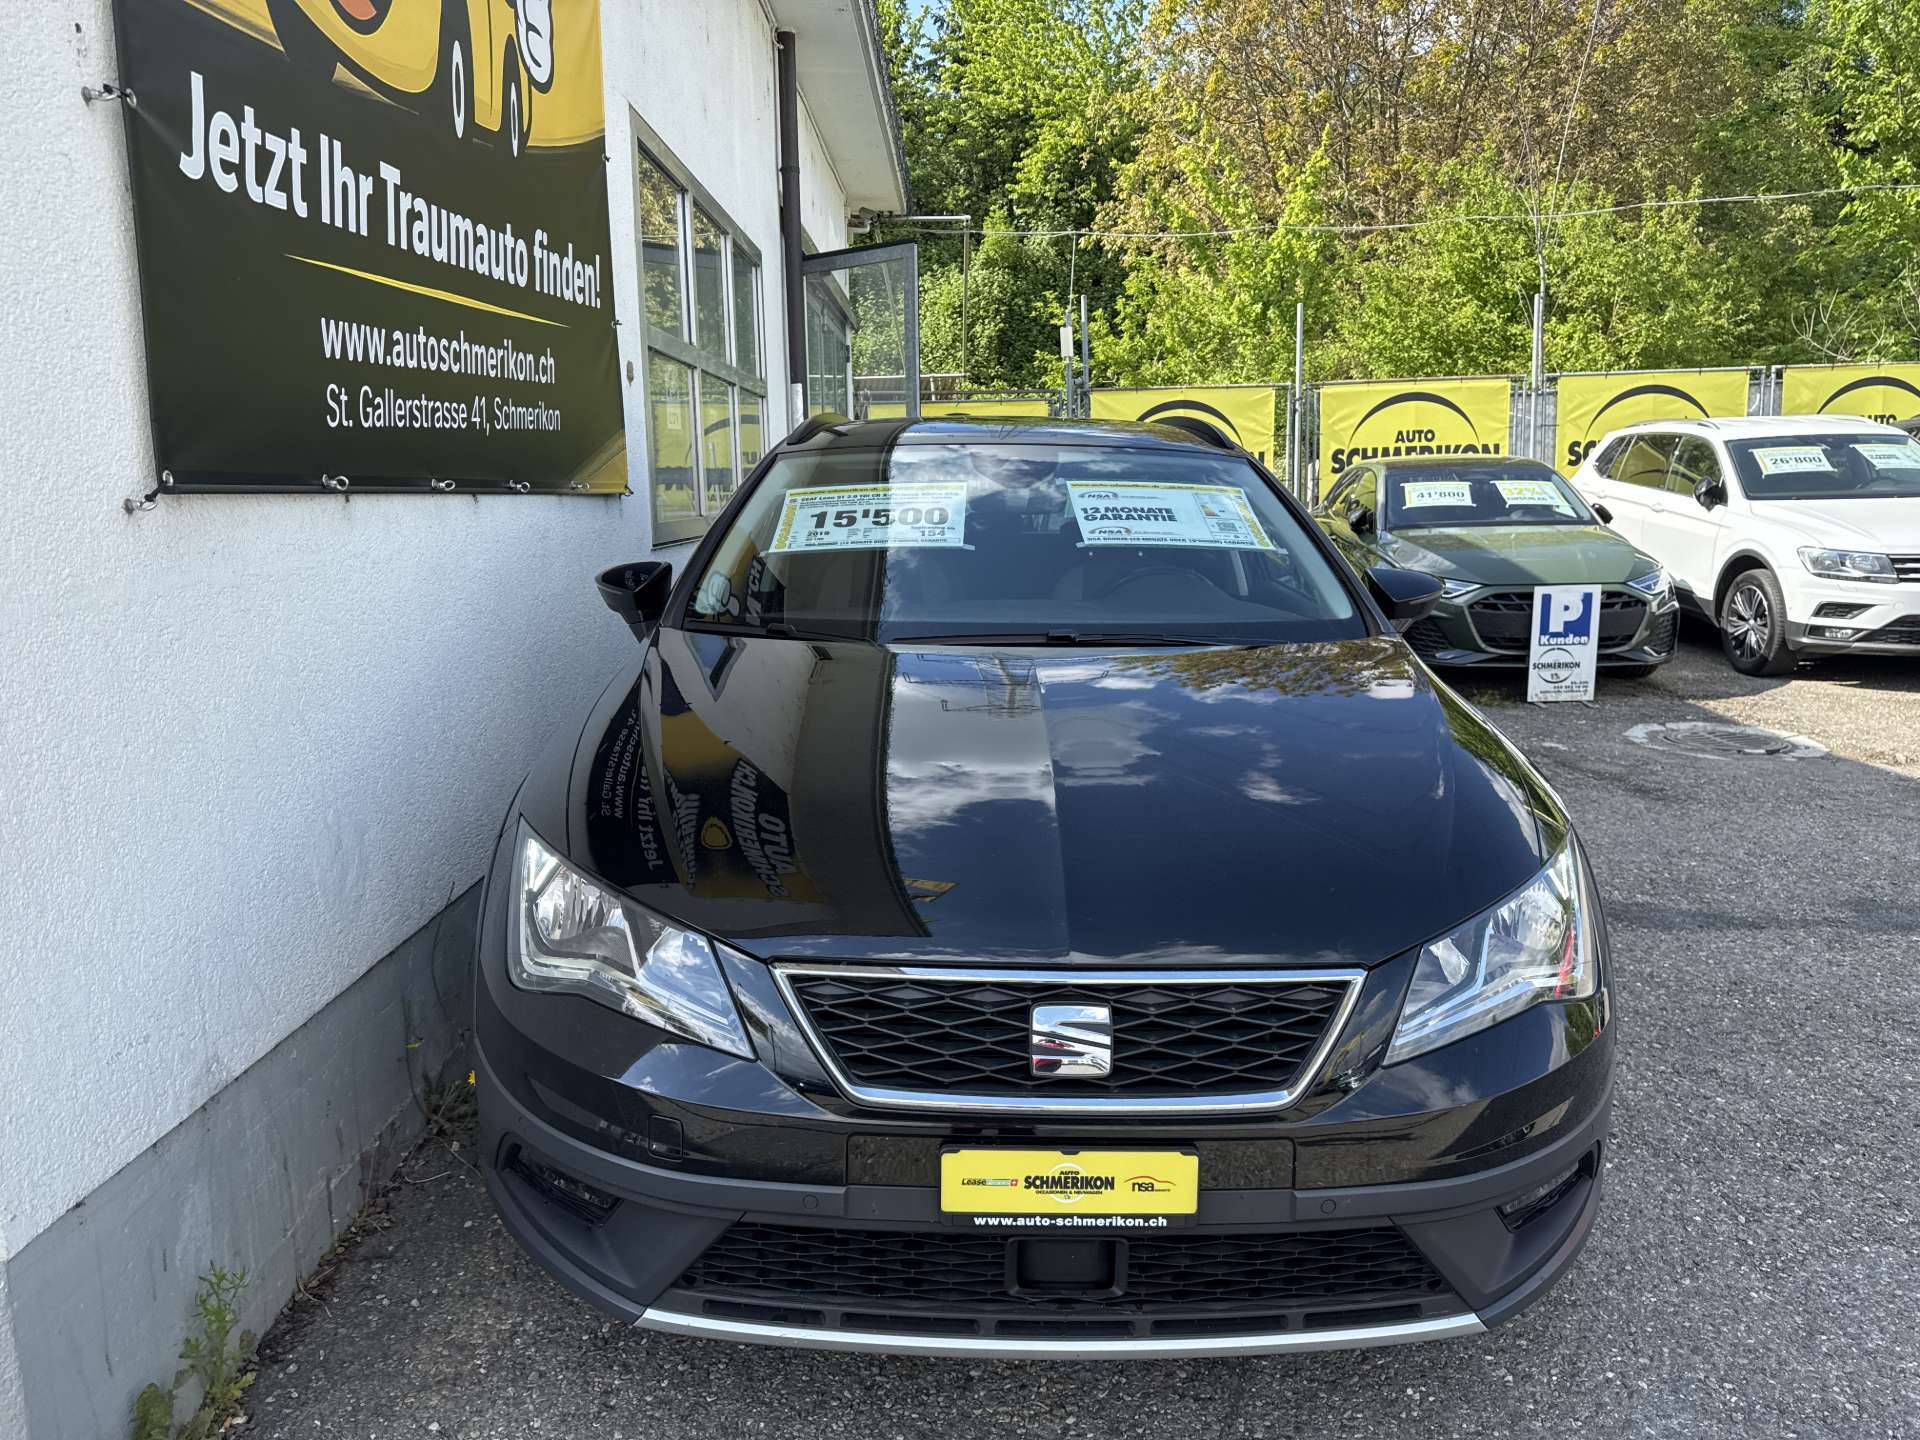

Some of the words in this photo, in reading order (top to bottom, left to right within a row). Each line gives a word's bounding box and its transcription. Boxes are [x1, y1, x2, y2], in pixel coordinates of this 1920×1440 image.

[179, 71, 308, 218] Jetzt
[319, 133, 373, 236] Ihr
[379, 160, 529, 288] Traumauto
[533, 228, 600, 309] finden!
[321, 317, 555, 384] www.autoschmerikon.ch
[326, 383, 353, 428] St.
[359, 385, 467, 429] Gallerstrasse
[471, 395, 490, 436] 41,
[494, 397, 560, 431] Schmerikon
[1861, 414, 1897, 425] UTO
[1395, 429, 1435, 444] AUTO
[1769, 456, 1823, 465] 26'800
[1104, 506, 1174, 514] MONATE
[810, 507, 949, 529] 15'500
[1084, 513, 1178, 521] GARANTIE
[1540, 634, 1590, 646] Kunden
[1532, 661, 1581, 671] SCHMERIKON
[961, 1178, 987, 1186] Lease
[1024, 1175, 1115, 1190] SCHMERIKON
[1132, 1182, 1154, 1192] nsa
[974, 1216, 1167, 1227] www.auto-schmerikon.ch
